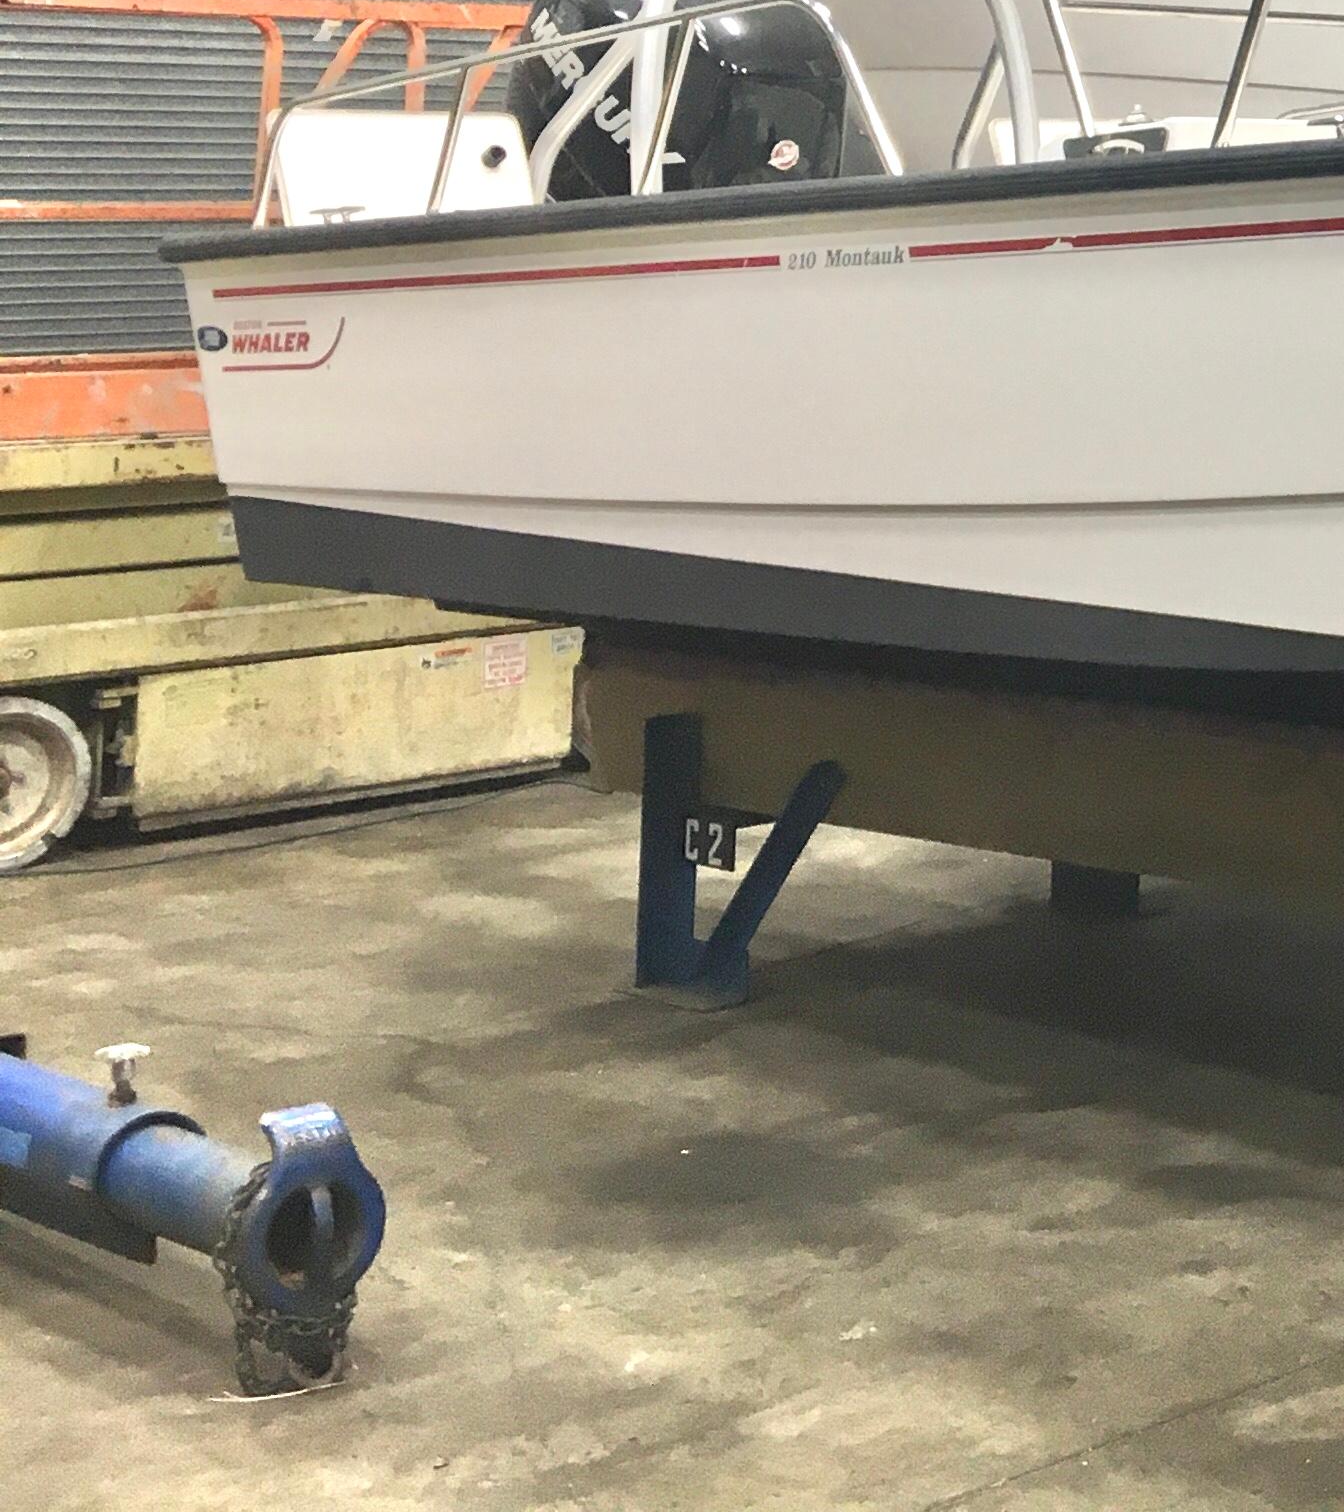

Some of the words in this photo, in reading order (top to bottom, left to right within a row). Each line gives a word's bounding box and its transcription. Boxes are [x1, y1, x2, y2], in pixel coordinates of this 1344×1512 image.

[787, 251, 817, 270] 210
[824, 245, 905, 268] Montauk
[232, 331, 310, 354] WHALER
